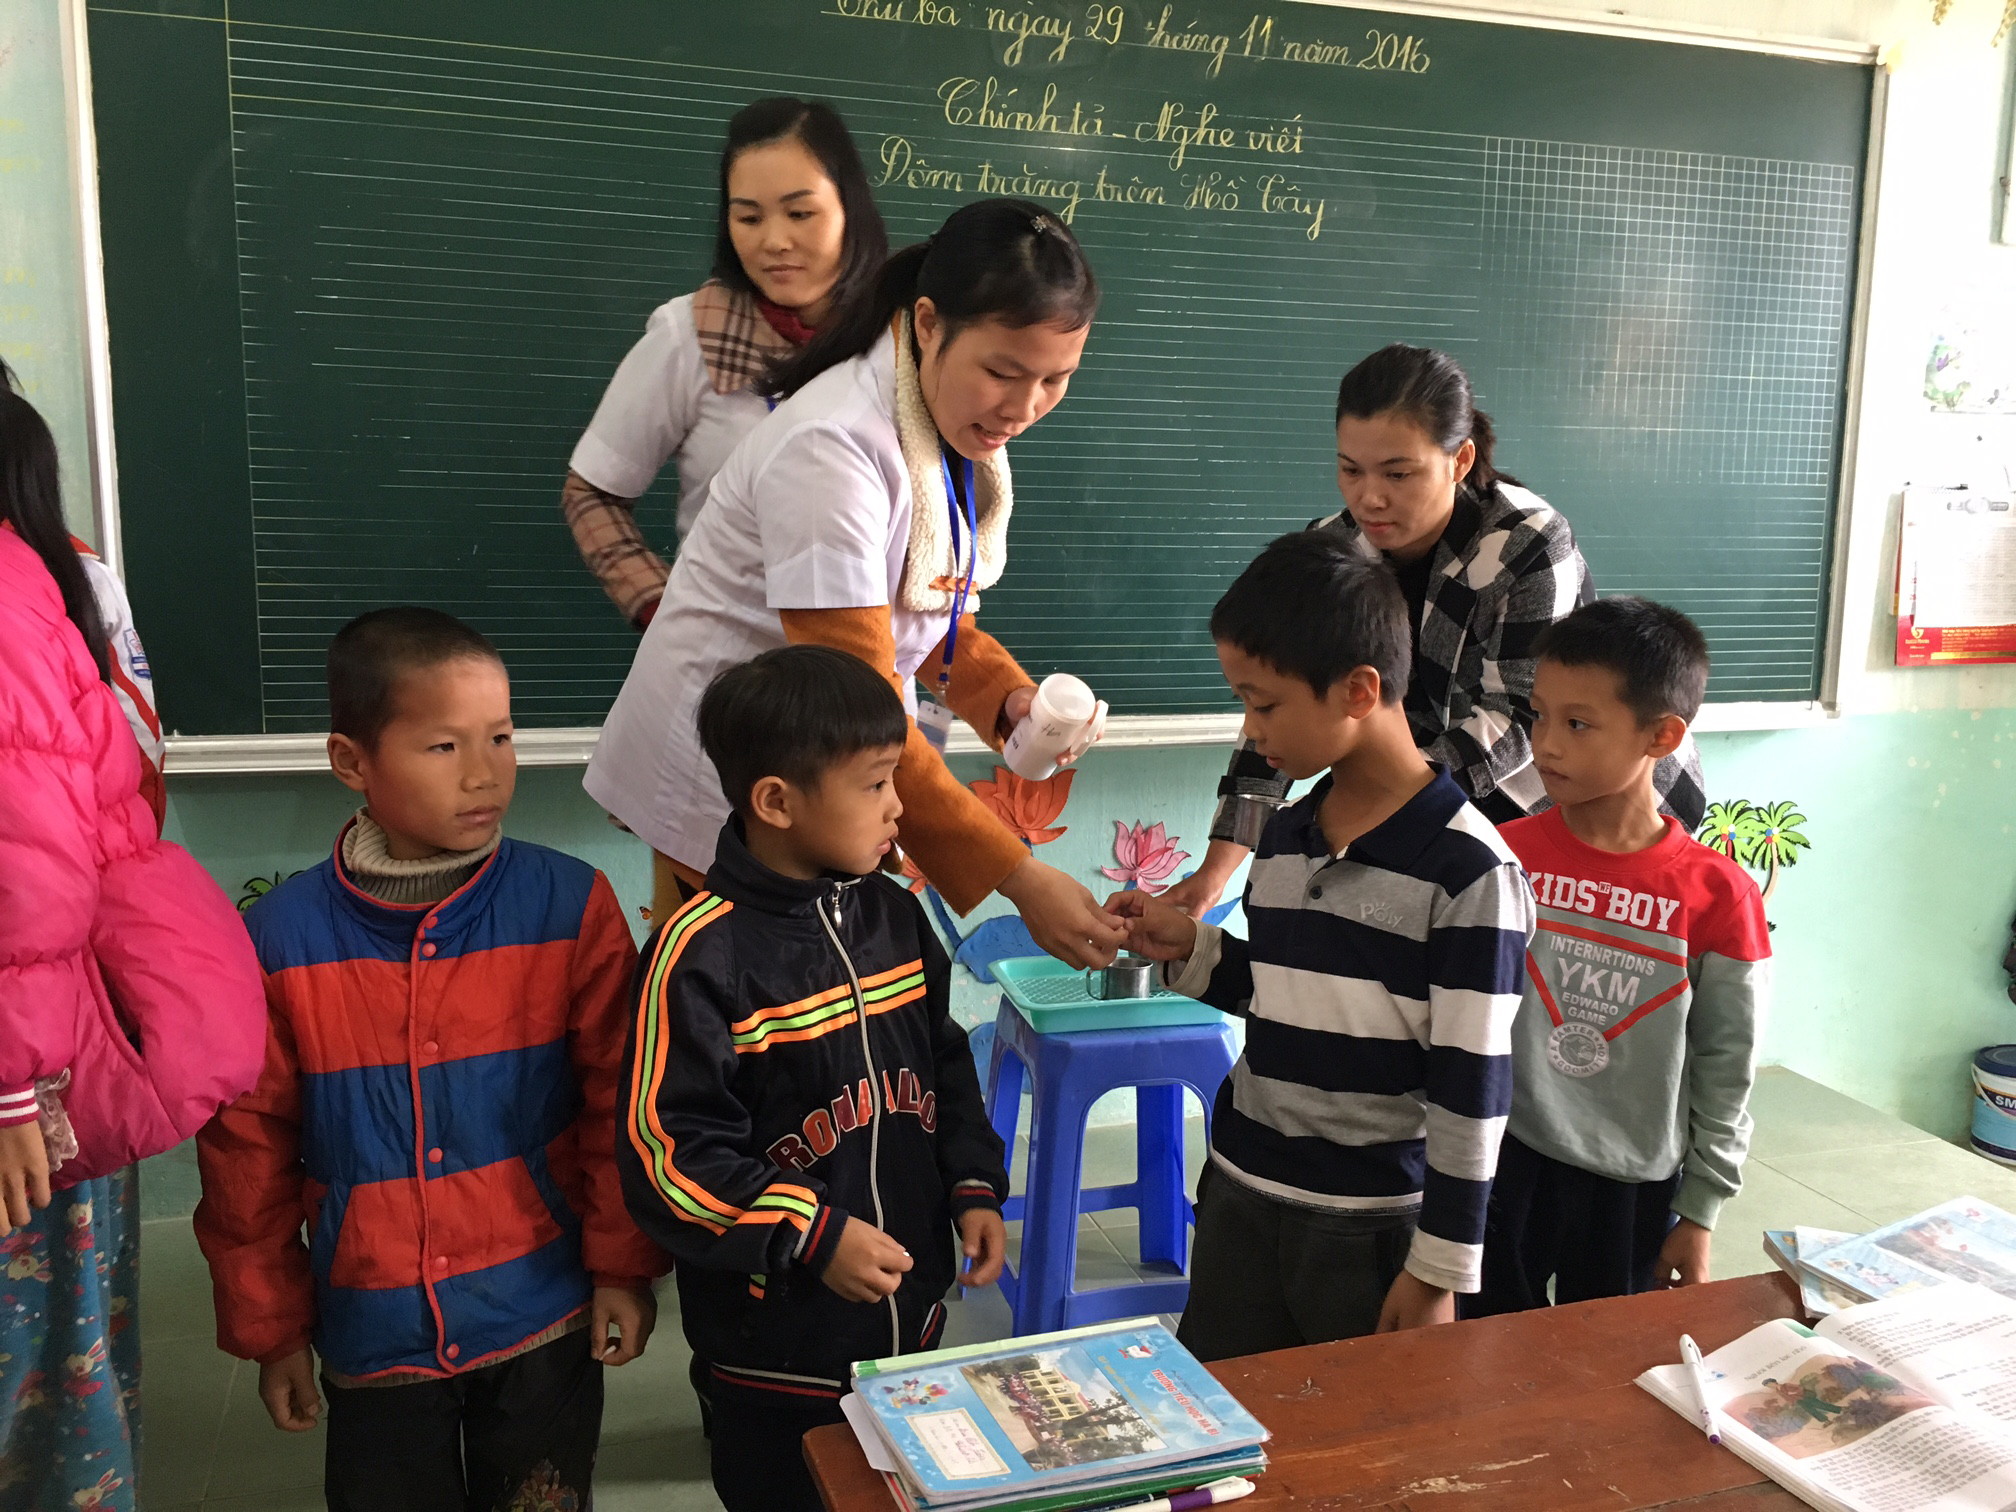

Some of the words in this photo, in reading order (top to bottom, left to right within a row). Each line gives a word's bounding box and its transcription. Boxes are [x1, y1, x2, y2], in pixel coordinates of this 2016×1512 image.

[1085, 3, 1124, 45] 29
[1239, 14, 1275, 62] 11
[1356, 29, 1431, 74] 2016
[1135, 101, 1236, 171] Nghe
[1527, 871, 1599, 914] KIDS
[1605, 886, 1680, 932] BOY
[1558, 957, 1640, 1006] YKM
[1567, 1006, 1606, 1026] GAME
